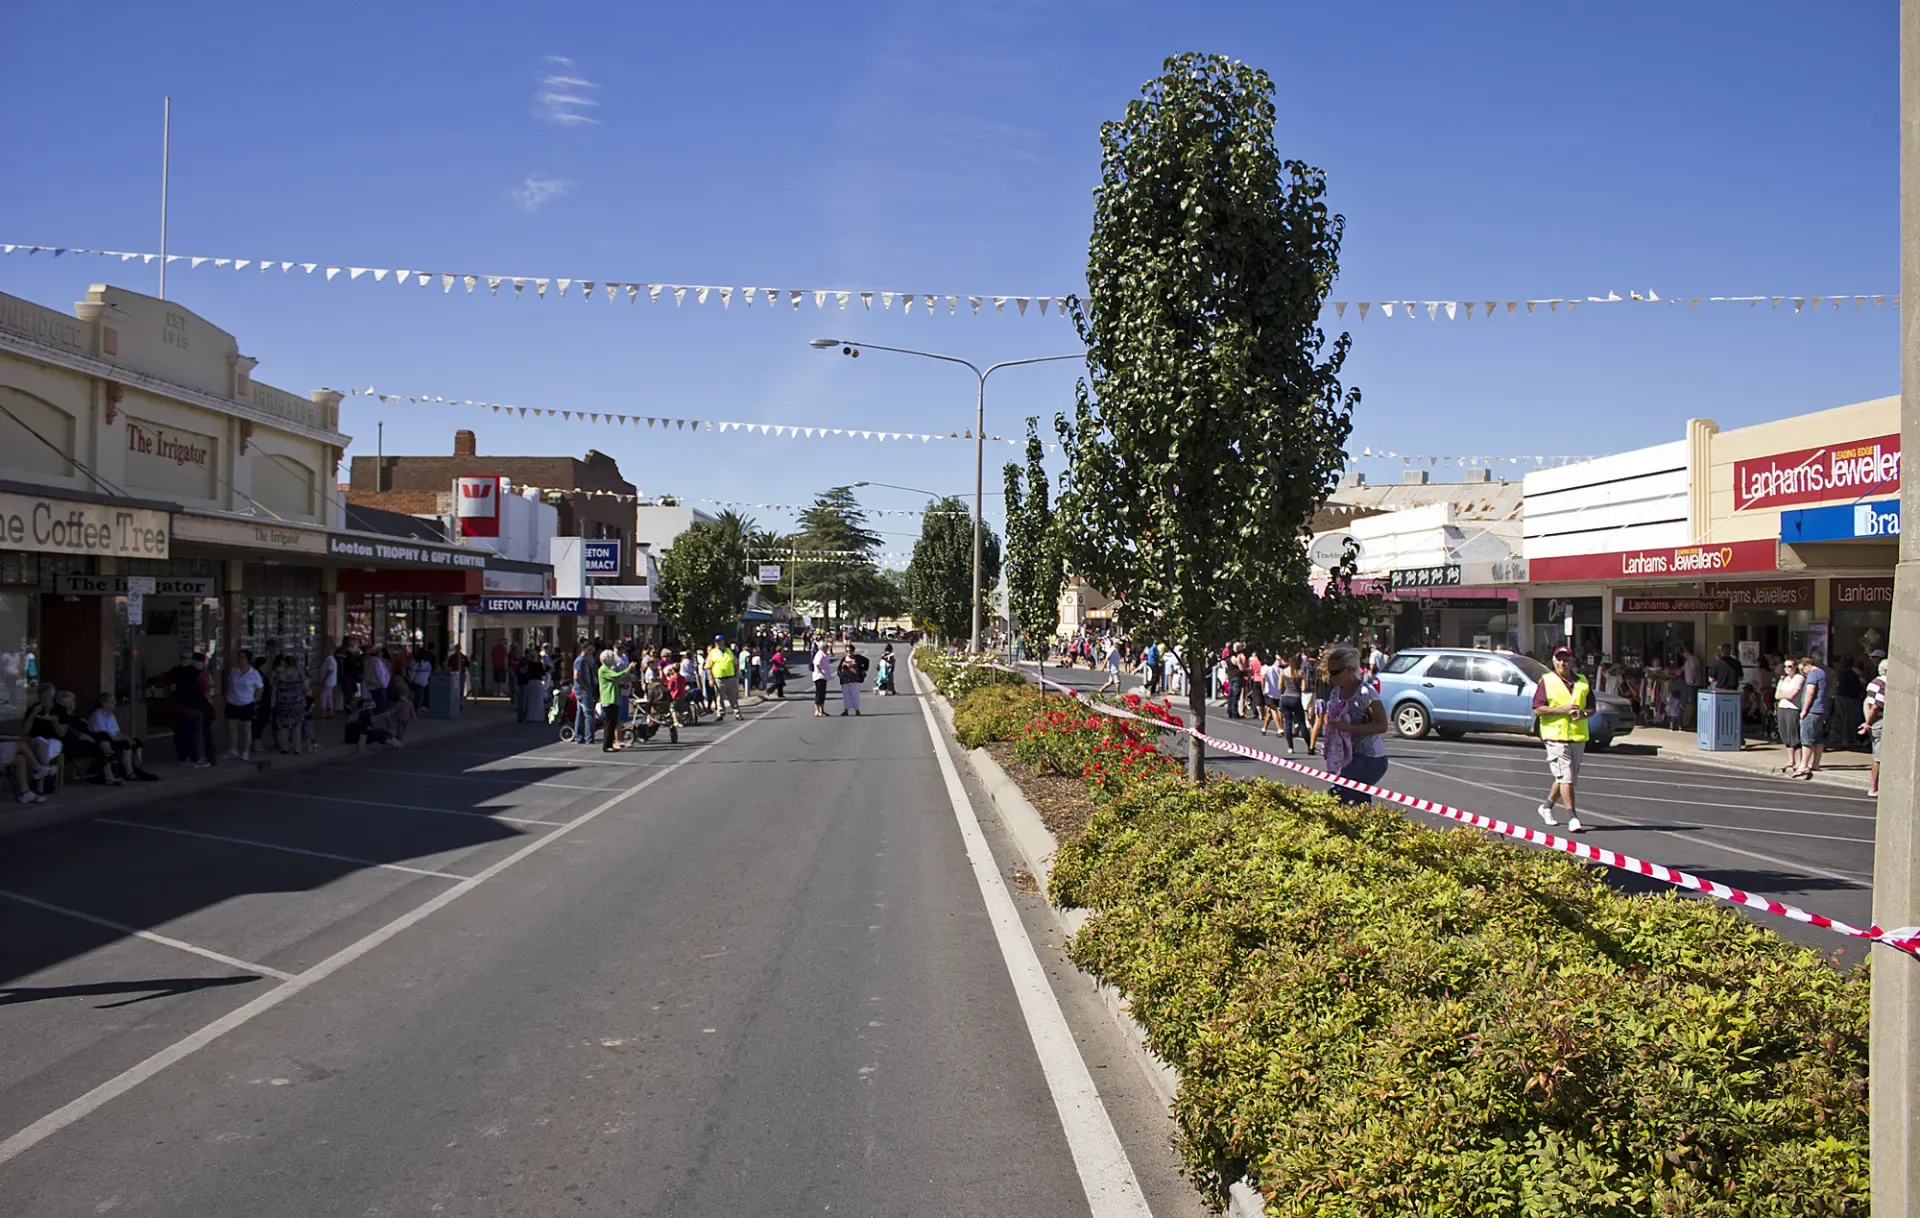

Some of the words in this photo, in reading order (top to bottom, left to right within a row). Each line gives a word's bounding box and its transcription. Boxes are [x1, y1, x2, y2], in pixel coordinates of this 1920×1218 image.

[127, 424, 153, 455] The
[156, 430, 207, 466] Irrigator
[1857, 446, 1874, 458] EDGE
[1741, 461, 1825, 500] Lanhams
[1824, 444, 1900, 490] Jeweller
[33, 502, 111, 549] Coffee
[116, 511, 165, 554] Tree
[1867, 510, 1900, 535] Bra
[331, 538, 373, 556] Leeton
[375, 544, 420, 561] TROPHY
[421, 550, 430, 562] &
[431, 551, 451, 564] GIFT
[452, 554, 486, 568] CENTRE
[1622, 552, 1668, 574] Lanhams
[1669, 547, 1721, 572] Jewellers
[586, 560, 615, 570] RMACY
[67, 577, 107, 592] The
[1838, 583, 1892, 602] Lanhams
[1711, 586, 1751, 604] Lanhams
[1752, 586, 1797, 604] Jewellers
[489, 600, 522, 611] LEETON
[526, 600, 579, 612] PHARMACY
[1629, 600, 1670, 611] Lanhams
[1671, 600, 1715, 611] Jewellers
